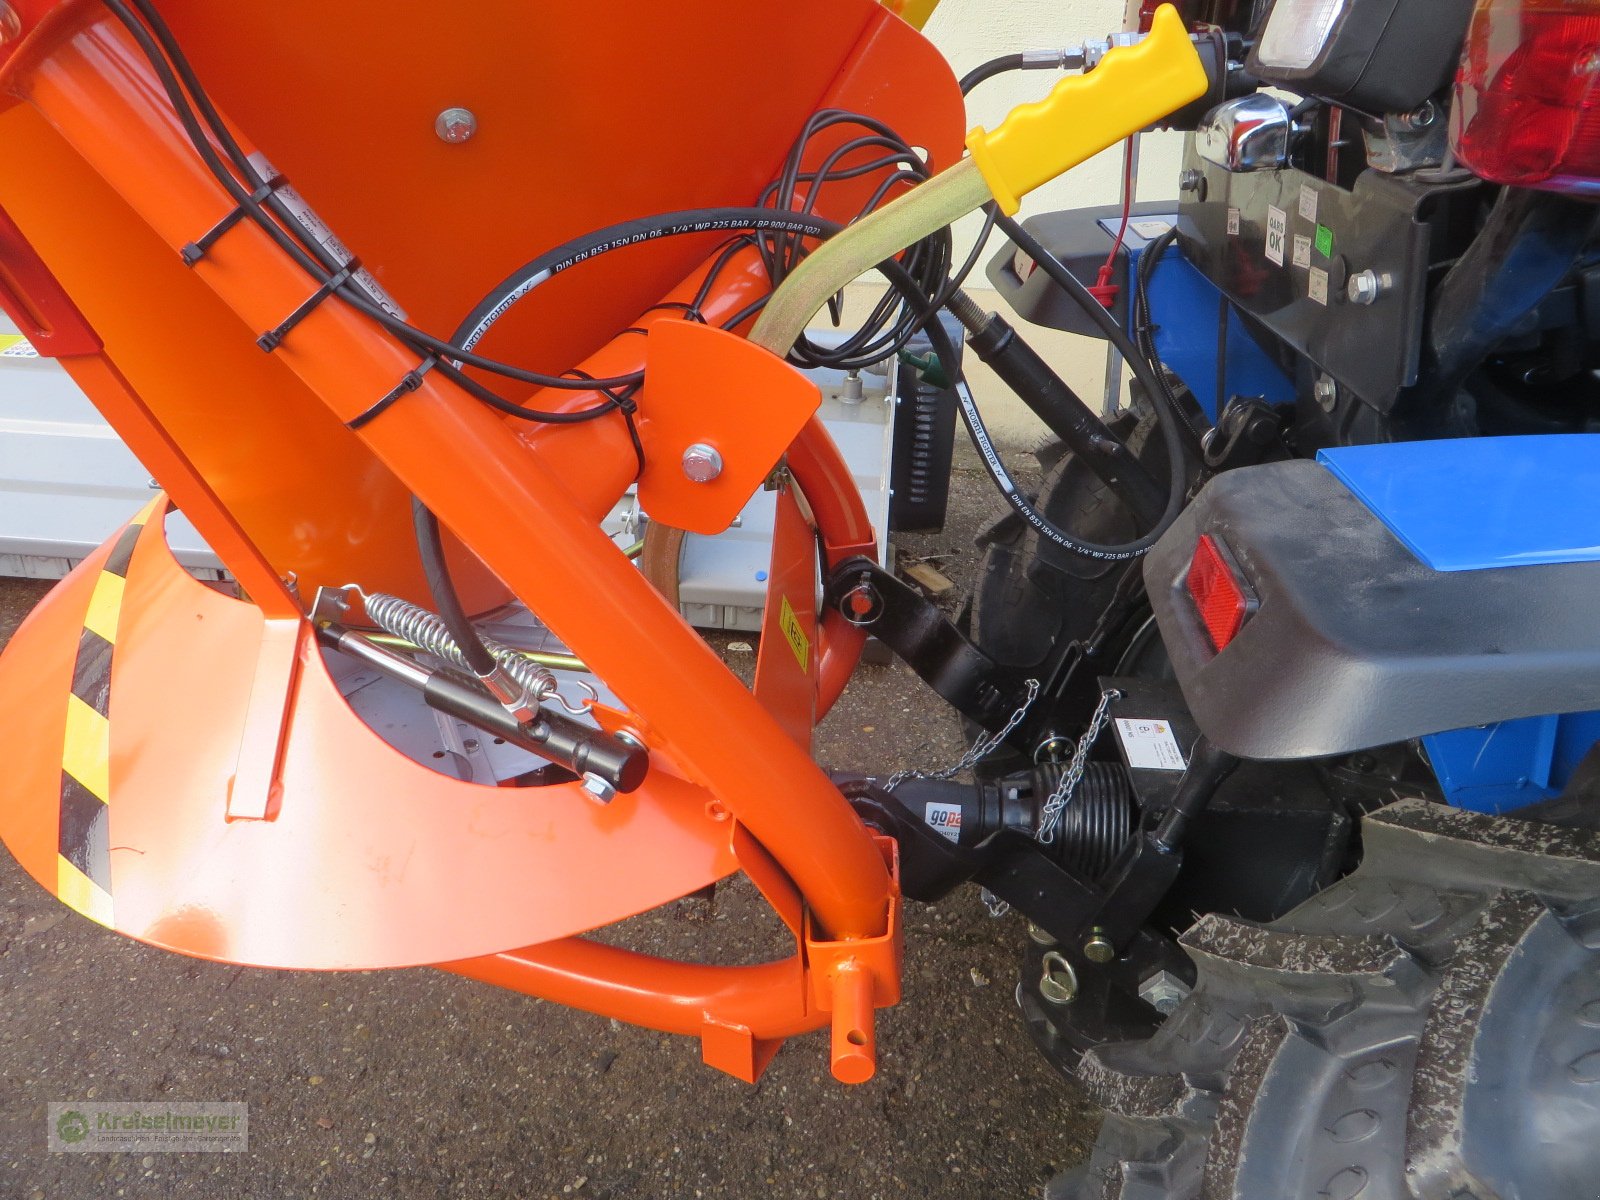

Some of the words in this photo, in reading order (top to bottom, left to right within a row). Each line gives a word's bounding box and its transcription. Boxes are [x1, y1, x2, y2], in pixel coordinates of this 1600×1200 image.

[1269, 217, 1284, 234] QARS
[555, 258, 573, 273] DIN
[575, 251, 588, 263] EN
[591, 243, 609, 257] 853
[632, 231, 647, 243] DN
[649, 228, 662, 239] 06
[694, 221, 711, 231] WP
[711, 220, 729, 229] 225
[730, 219, 749, 228] BAR
[757, 220, 770, 229] BP
[769, 221, 786, 229] 900
[786, 221, 803, 232] BAR
[1269, 231, 1282, 253] OK
[463, 326, 484, 354] ORTH
[967, 408, 983, 435] NORTH
[1011, 494, 1024, 507] DIN
[1021, 505, 1032, 516] EN
[1029, 514, 1043, 527] 853
[1052, 534, 1064, 543] DN
[1062, 540, 1073, 549] 06
[1116, 552, 1130, 560] BAR
